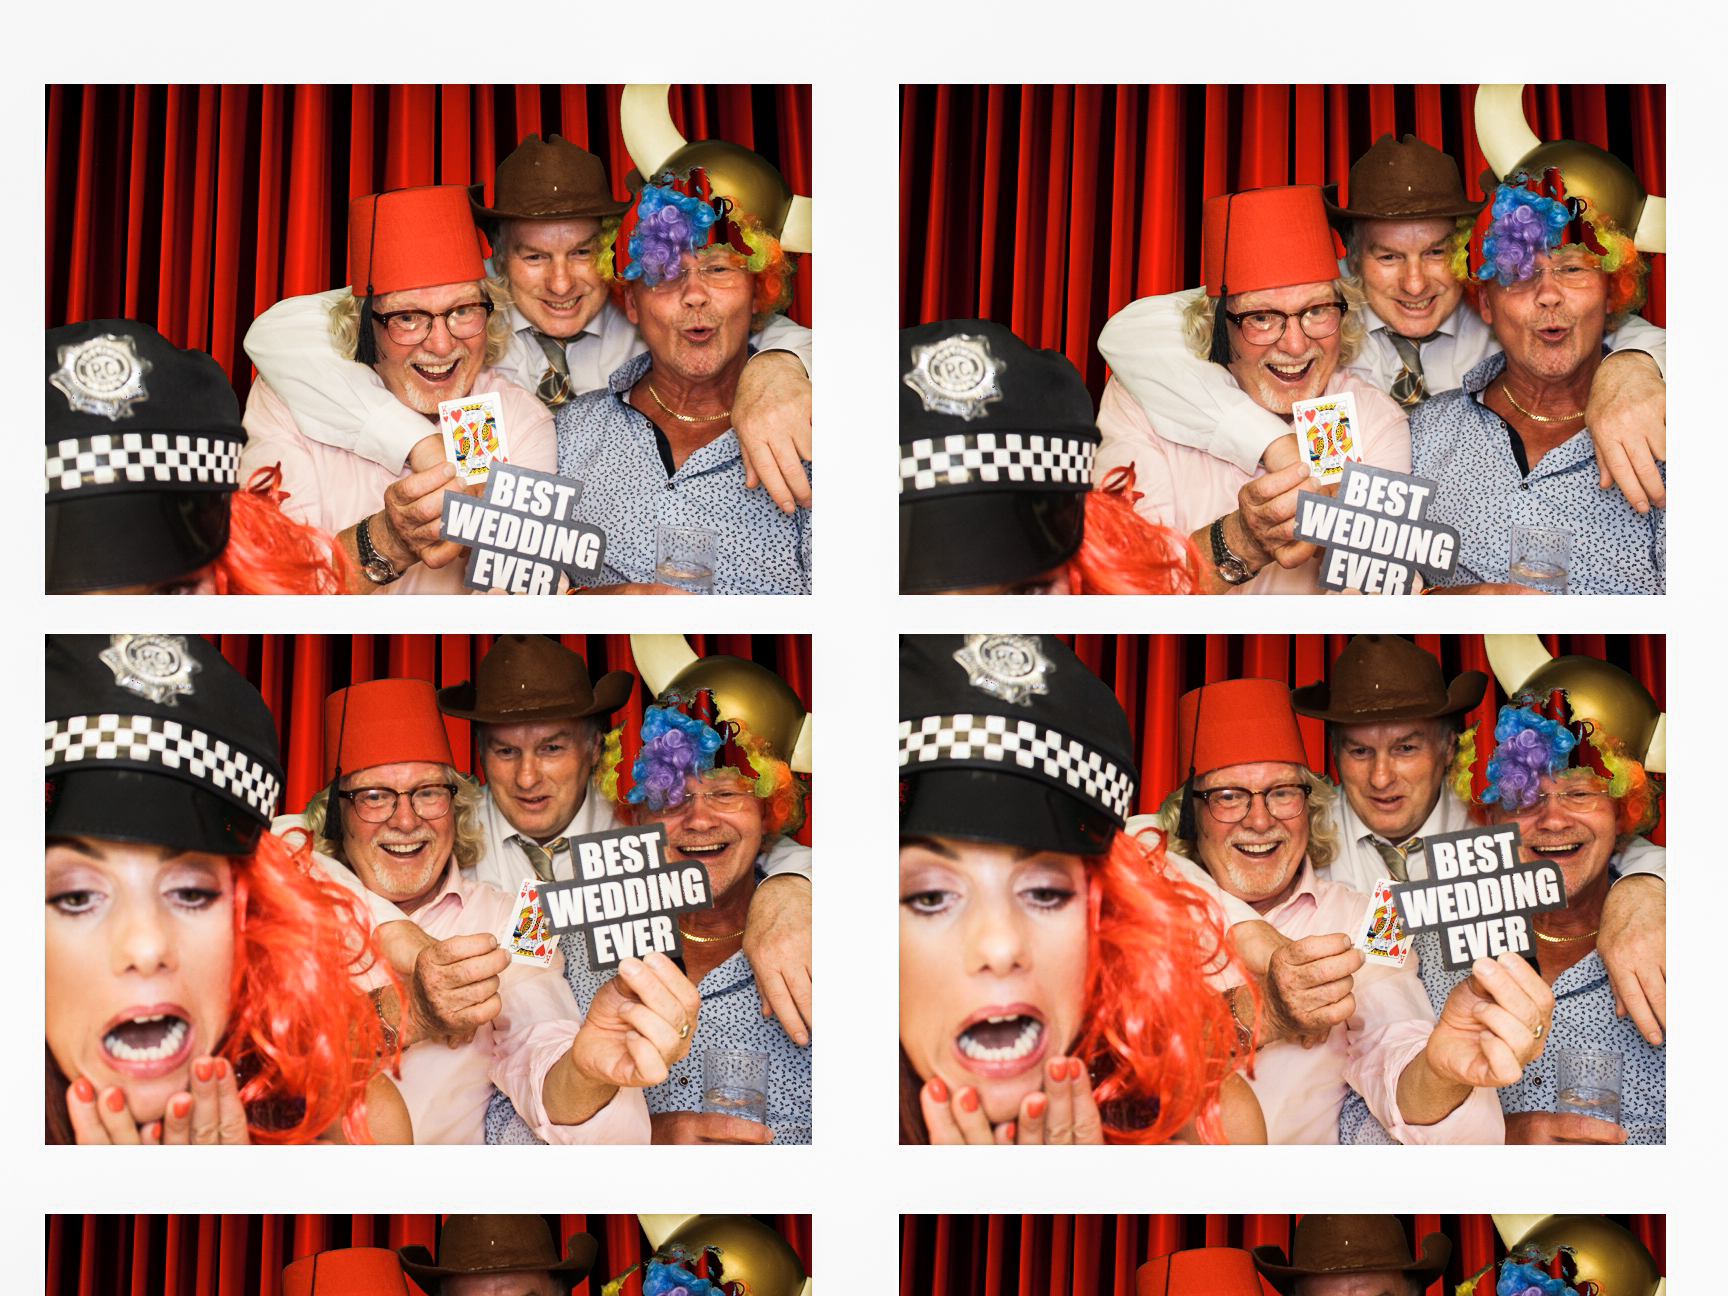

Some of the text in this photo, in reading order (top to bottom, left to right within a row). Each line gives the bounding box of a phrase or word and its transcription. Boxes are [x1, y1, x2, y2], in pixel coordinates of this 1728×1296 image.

[88, 360, 119, 378] PC
[942, 360, 973, 378] PC
[441, 405, 449, 415] K
[1295, 405, 1303, 415] K
[489, 470, 576, 521] BEST
[1343, 470, 1430, 521] BEST
[446, 500, 601, 571] WEDDING
[1300, 500, 1455, 571] WEDDING
[472, 549, 554, 595] EVER
[1326, 549, 1408, 595] EVER
[578, 832, 661, 880] BEST
[1432, 832, 1515, 880] BEST
[522, 881, 530, 892] K
[546, 867, 706, 929] WEDDING
[1376, 881, 1384, 892] K
[1400, 867, 1560, 929] WEDDING
[544, 954, 552, 964] K
[593, 915, 676, 964] EVER
[1398, 954, 1406, 964] K
[1447, 915, 1530, 964] EVER
